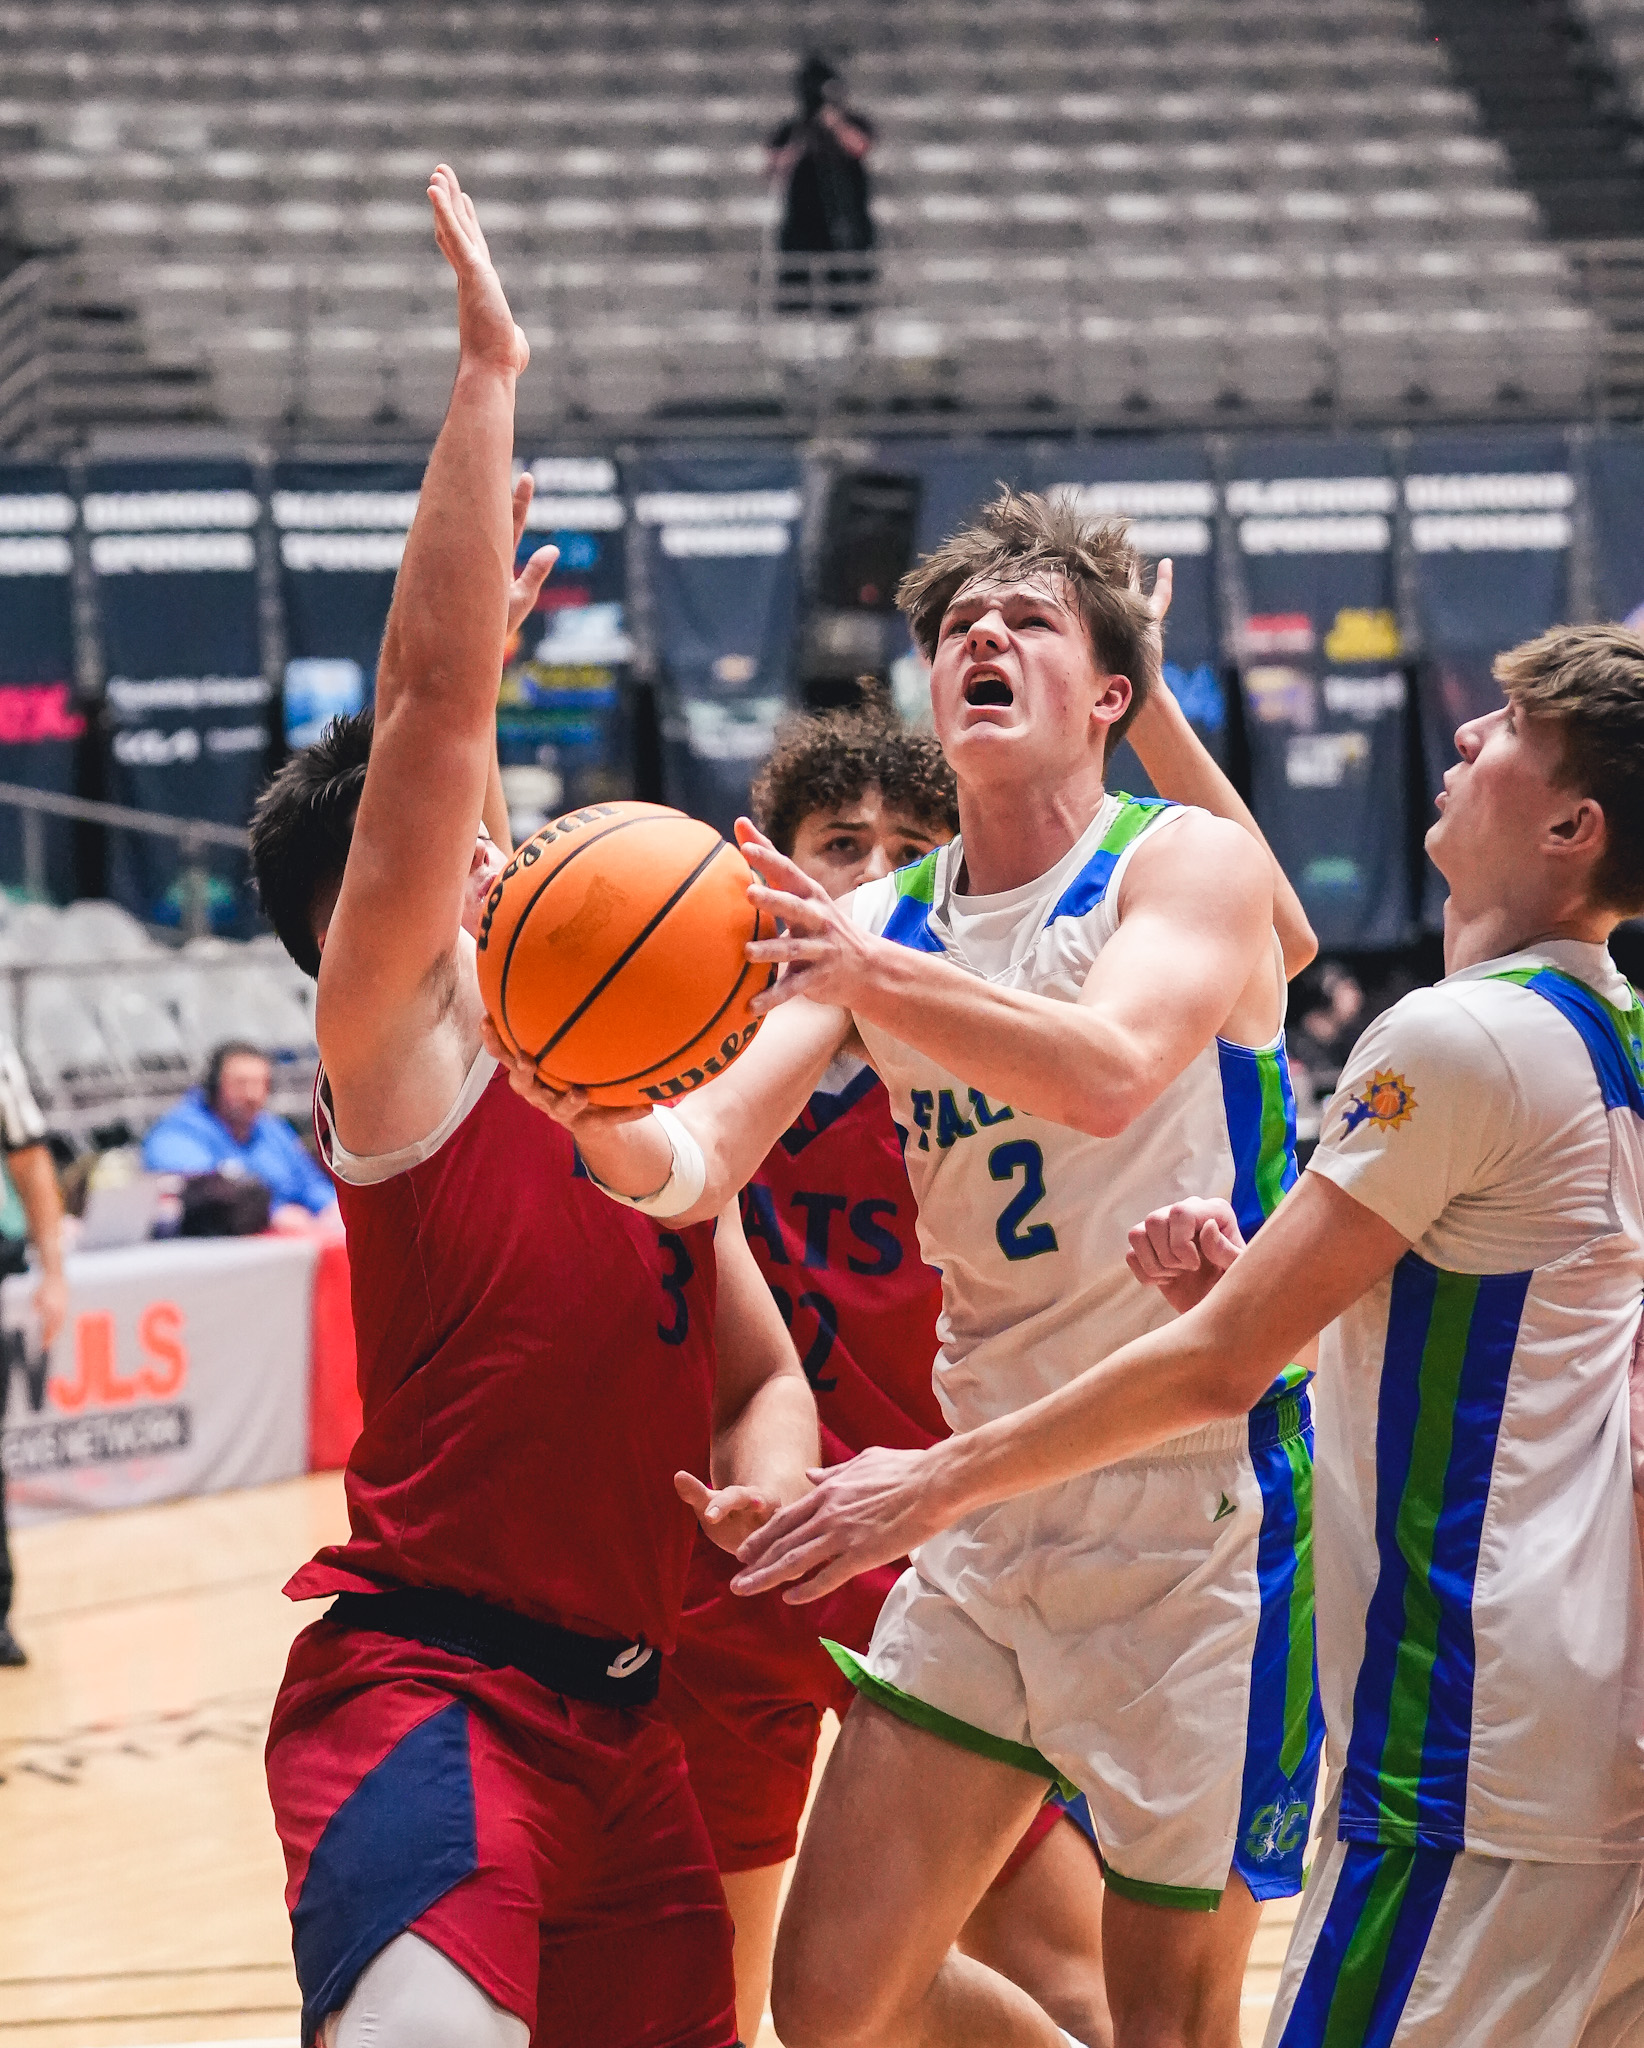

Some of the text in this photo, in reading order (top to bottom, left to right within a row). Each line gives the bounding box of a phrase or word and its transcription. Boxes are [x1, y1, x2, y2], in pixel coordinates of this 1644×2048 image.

[638, 1014, 764, 1101] Wils
[911, 1086, 1033, 1152] FAL
[738, 1182, 904, 1276] ATS
[988, 1138, 1059, 1262] 2
